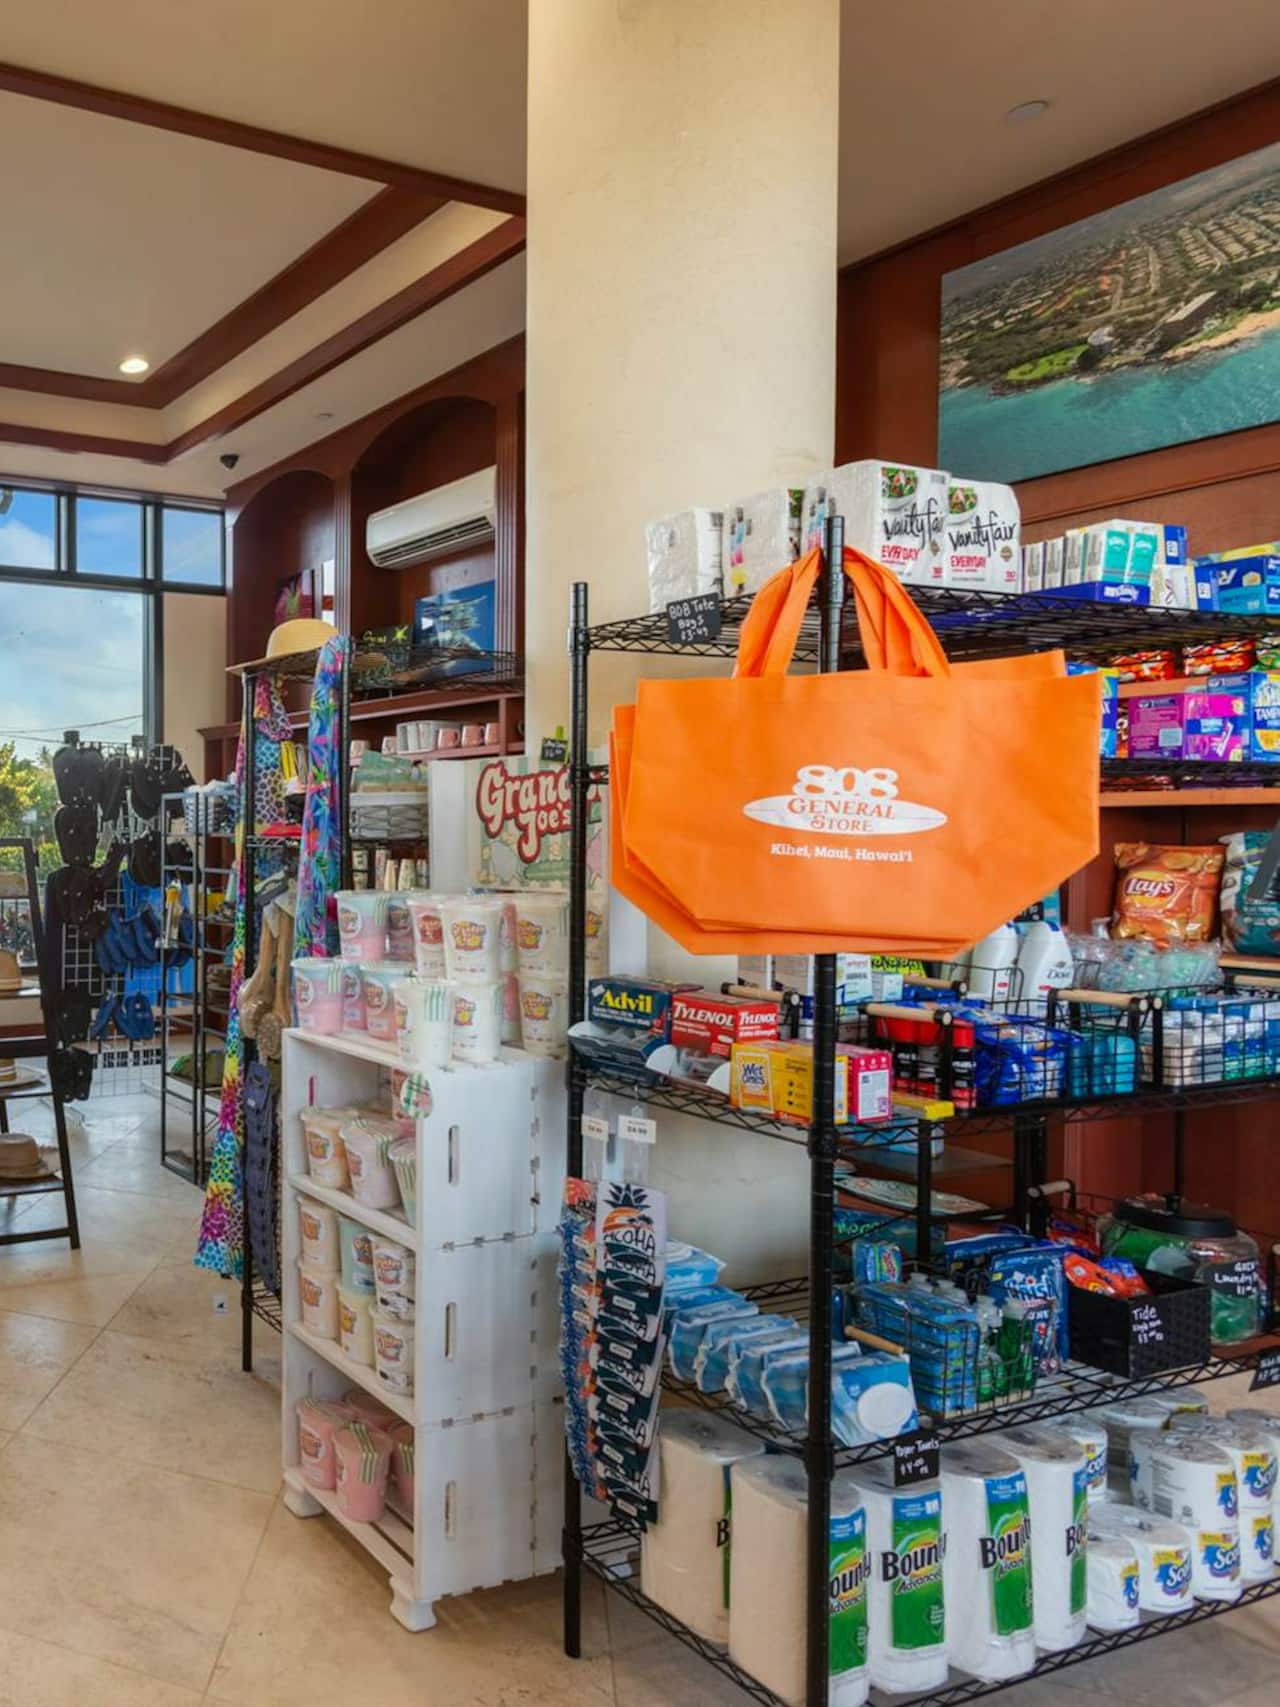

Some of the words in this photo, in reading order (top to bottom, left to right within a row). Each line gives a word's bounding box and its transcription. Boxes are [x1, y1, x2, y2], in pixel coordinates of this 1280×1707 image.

[950, 555, 986, 568] EVERYDAY
[669, 604, 691, 620] 808
[793, 764, 899, 799] 808
[787, 797, 897, 820] GENERAL
[810, 814, 874, 832] STORE
[771, 843, 811, 860] Kihei,
[814, 846, 853, 861] Maui,
[599, 990, 653, 1014] Advil
[673, 1001, 734, 1027] TYLENOL
[739, 1010, 777, 1026] TYLENOL
[603, 1226, 656, 1258] ALOHA
[1132, 1304, 1158, 1321] Tide
[979, 1513, 1031, 1569] Boun
[882, 1533, 947, 1582] Bount
[830, 1551, 871, 1600] ount
[895, 1570, 943, 1595] Advance
